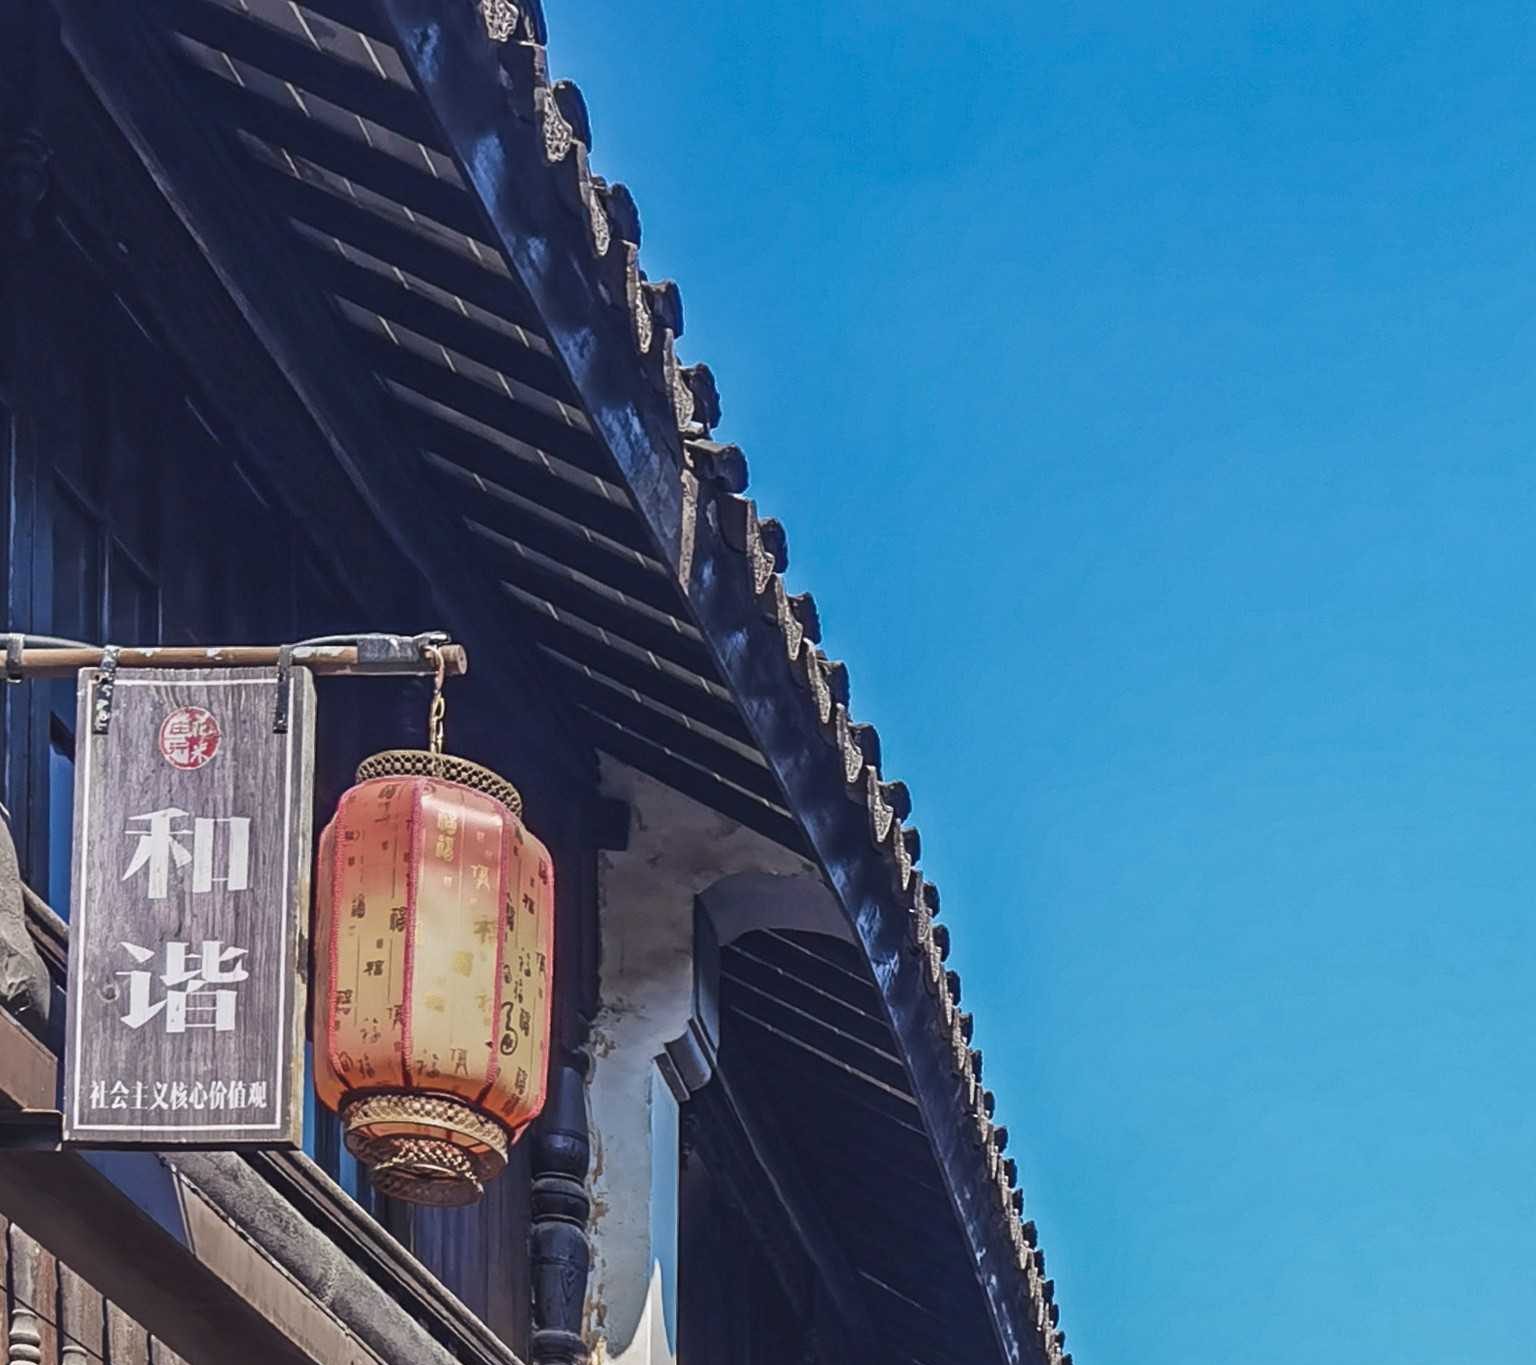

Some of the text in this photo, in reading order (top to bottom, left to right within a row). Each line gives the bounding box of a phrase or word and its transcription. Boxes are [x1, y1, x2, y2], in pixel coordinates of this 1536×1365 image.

[116, 807, 251, 1033] 和谐
[89, 1080, 267, 1110] 社会主义核心价值观
